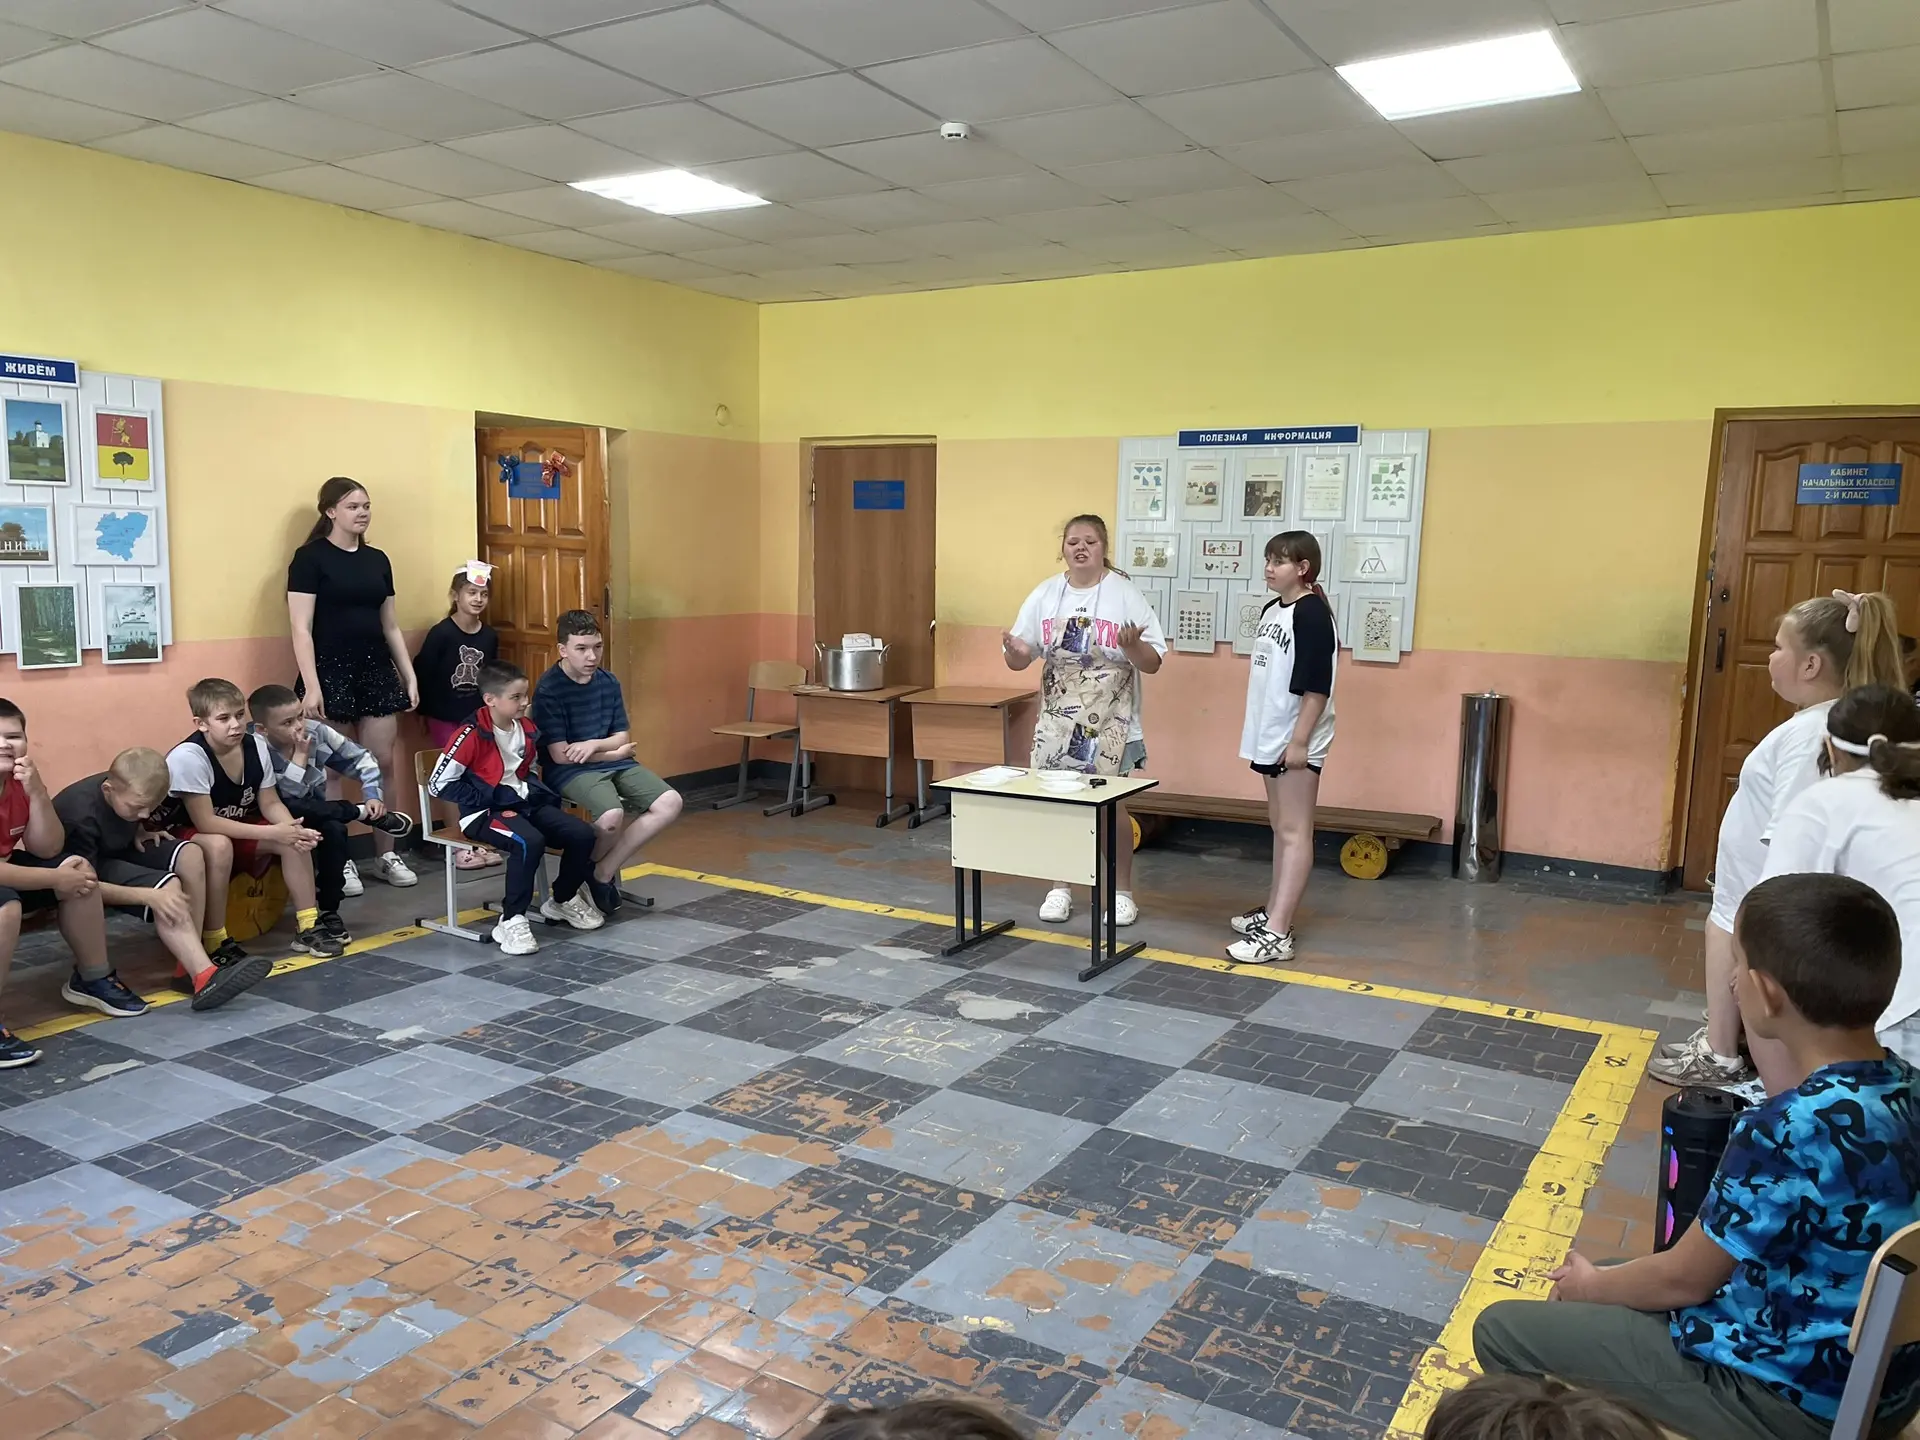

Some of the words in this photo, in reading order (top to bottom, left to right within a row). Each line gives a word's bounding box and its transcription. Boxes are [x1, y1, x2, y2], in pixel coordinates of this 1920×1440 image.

[5, 362, 56, 377] ЖИВЁМ
[1199, 433, 1248, 442] ПОЛЕЗНАЯ
[1264, 431, 1332, 441] ИНФОРМАЦИЯ
[1830, 468, 1869, 476] КАБИНЕТ
[1802, 479, 1854, 487] НАЧАЛЬНЫХ
[1856, 478, 1896, 486] КЛАССОВ
[1825, 490, 1839, 499] 2-Й
[1841, 491, 1870, 499] КЛАСС
[1268, 624, 1291, 655] TEAM
